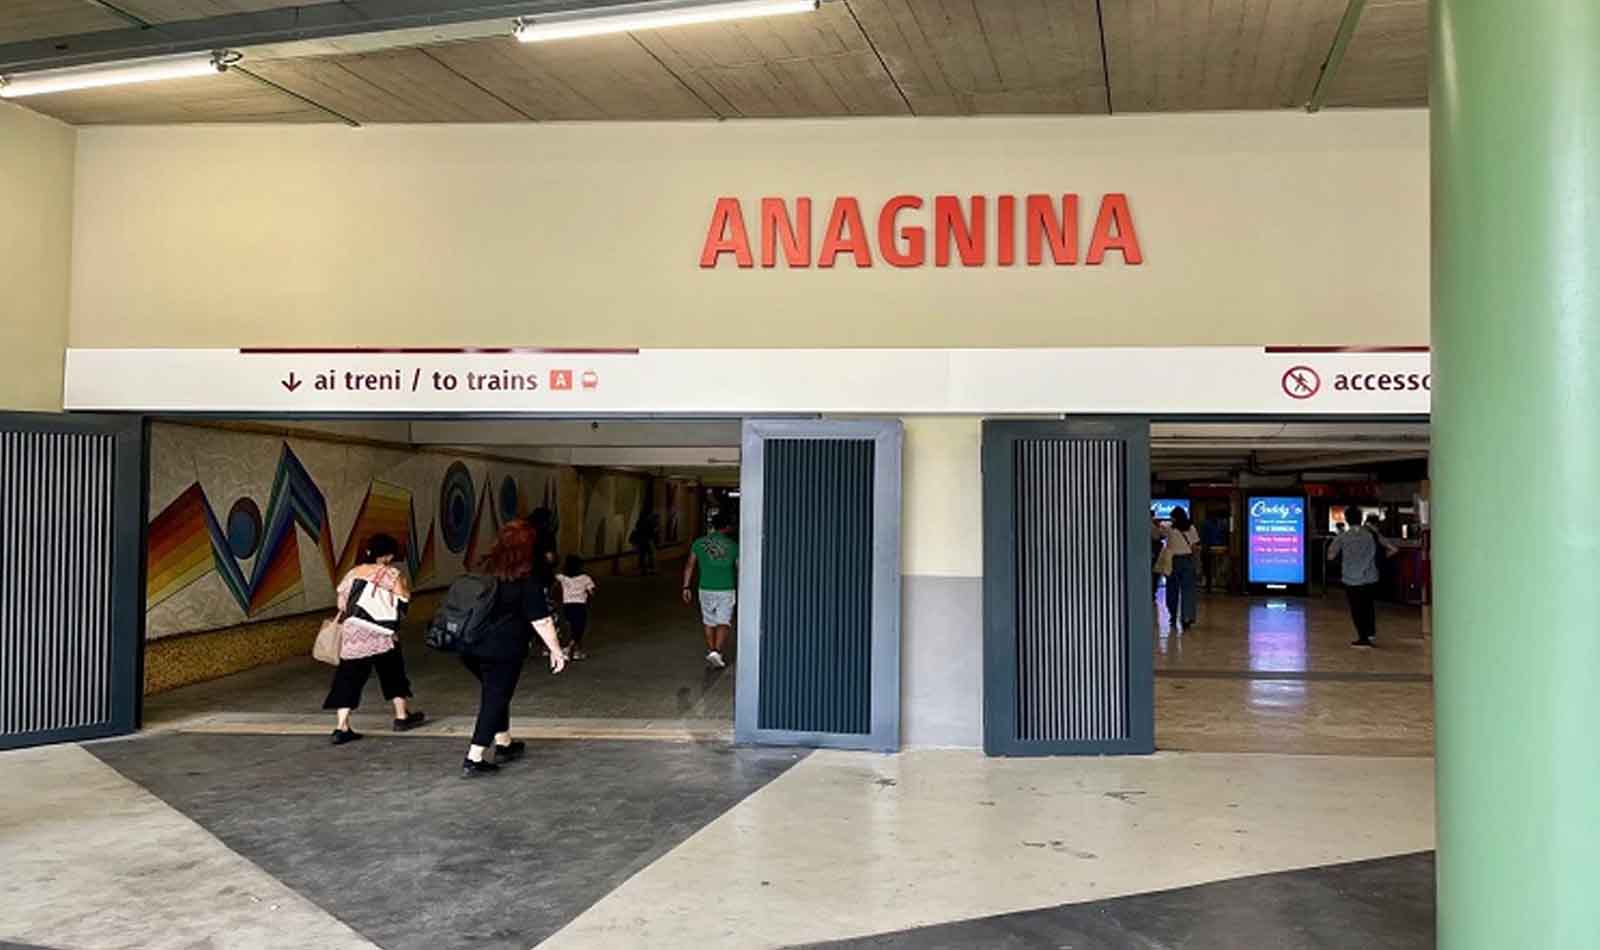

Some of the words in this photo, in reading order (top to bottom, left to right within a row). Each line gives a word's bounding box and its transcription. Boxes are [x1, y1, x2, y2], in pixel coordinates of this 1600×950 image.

[699, 193, 1143, 268] ANAGNINA
[314, 369, 335, 390] ai
[344, 369, 401, 390] treni
[411, 367, 421, 392] /
[431, 371, 458, 390] to
[466, 369, 538, 391] trains
